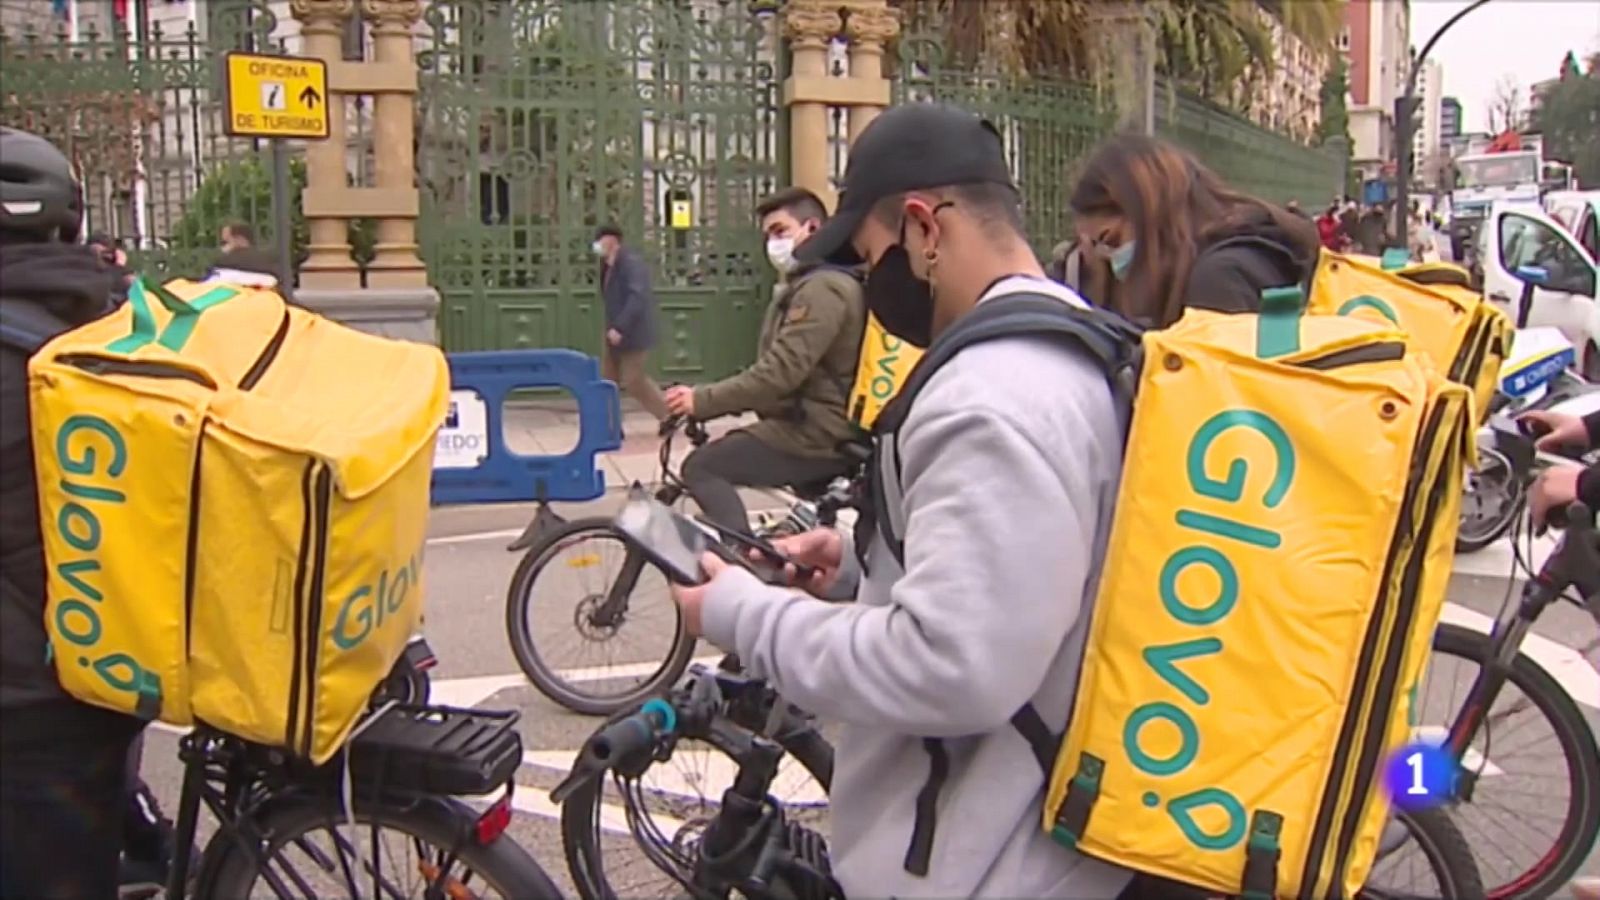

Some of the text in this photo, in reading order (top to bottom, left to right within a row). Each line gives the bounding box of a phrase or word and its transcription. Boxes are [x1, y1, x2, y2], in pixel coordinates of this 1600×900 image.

[236, 113, 323, 132] DE TURISMO
[248, 62, 309, 77] OFICINA
[55, 413, 128, 647] Glovo
[1122, 408, 1297, 777] Glovo
